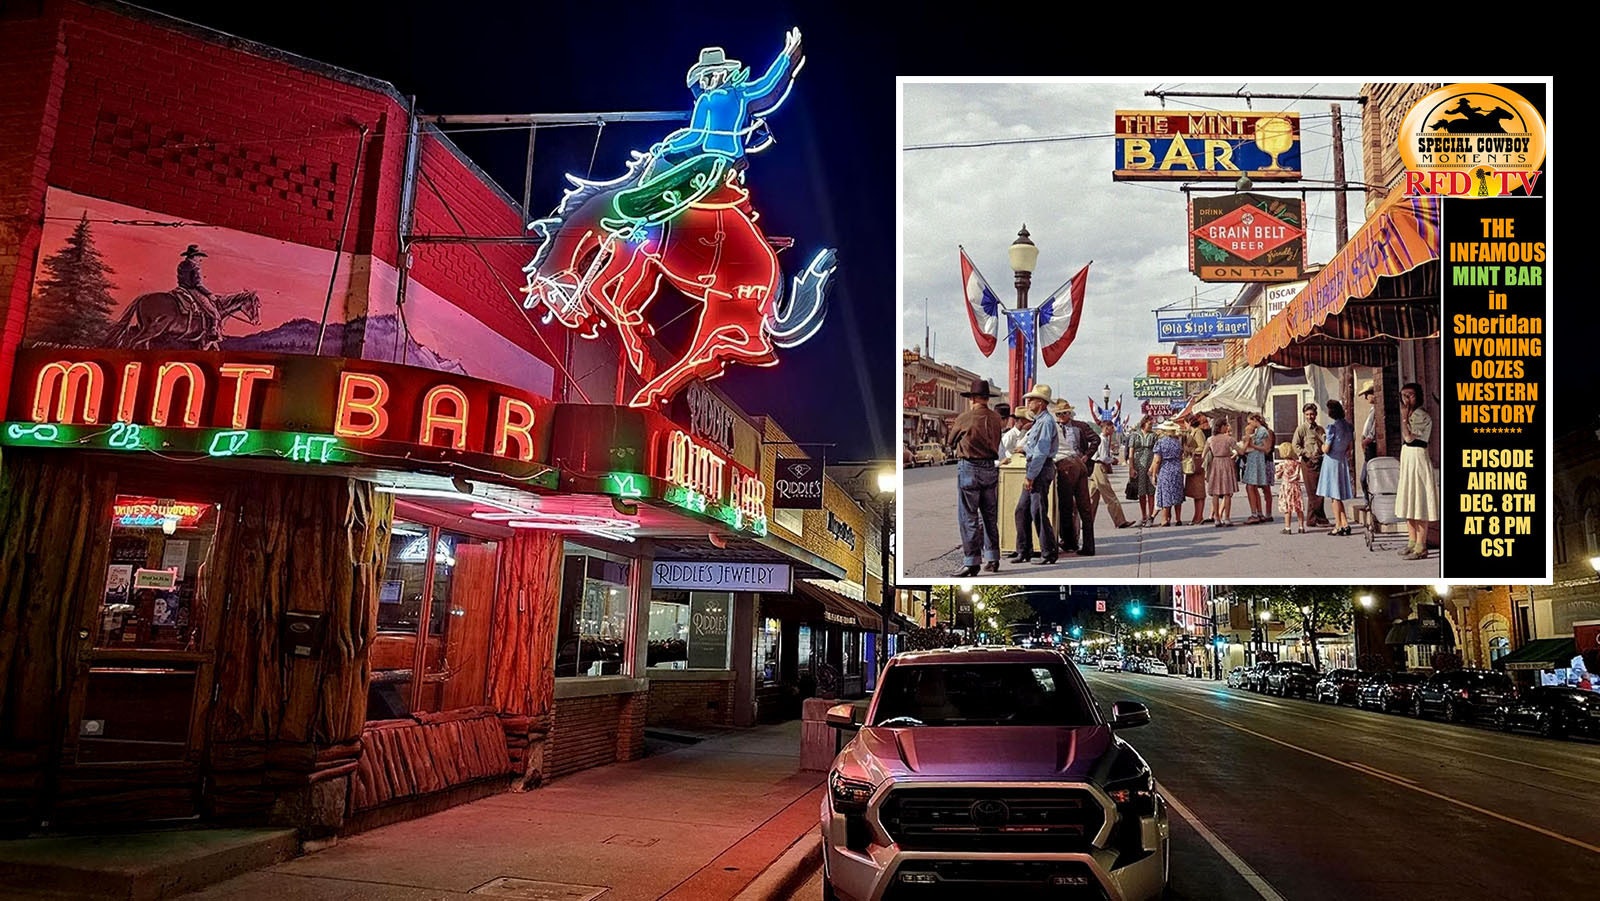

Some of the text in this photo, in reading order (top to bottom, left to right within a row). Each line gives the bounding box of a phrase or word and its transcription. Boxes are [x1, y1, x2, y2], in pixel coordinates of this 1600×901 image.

[1121, 113, 1248, 136] THE MINT
[1124, 131, 1240, 171] BAR
[1200, 208, 1223, 216] DRINK
[1209, 226, 1286, 239] GRAIN BELT
[1231, 241, 1264, 251] BEER
[1214, 268, 1284, 277] ON TAP
[1269, 288, 1296, 300] OSCAR
[1162, 321, 1247, 335] Old Style Lager
[1153, 357, 1191, 366] GREEN
[32, 361, 275, 430] MINT
[333, 371, 536, 462] BAR
[776, 479, 821, 499] RIDDLE'S
[654, 562, 713, 585] RIDDLE'S
[716, 566, 776, 586] JEWELRY
